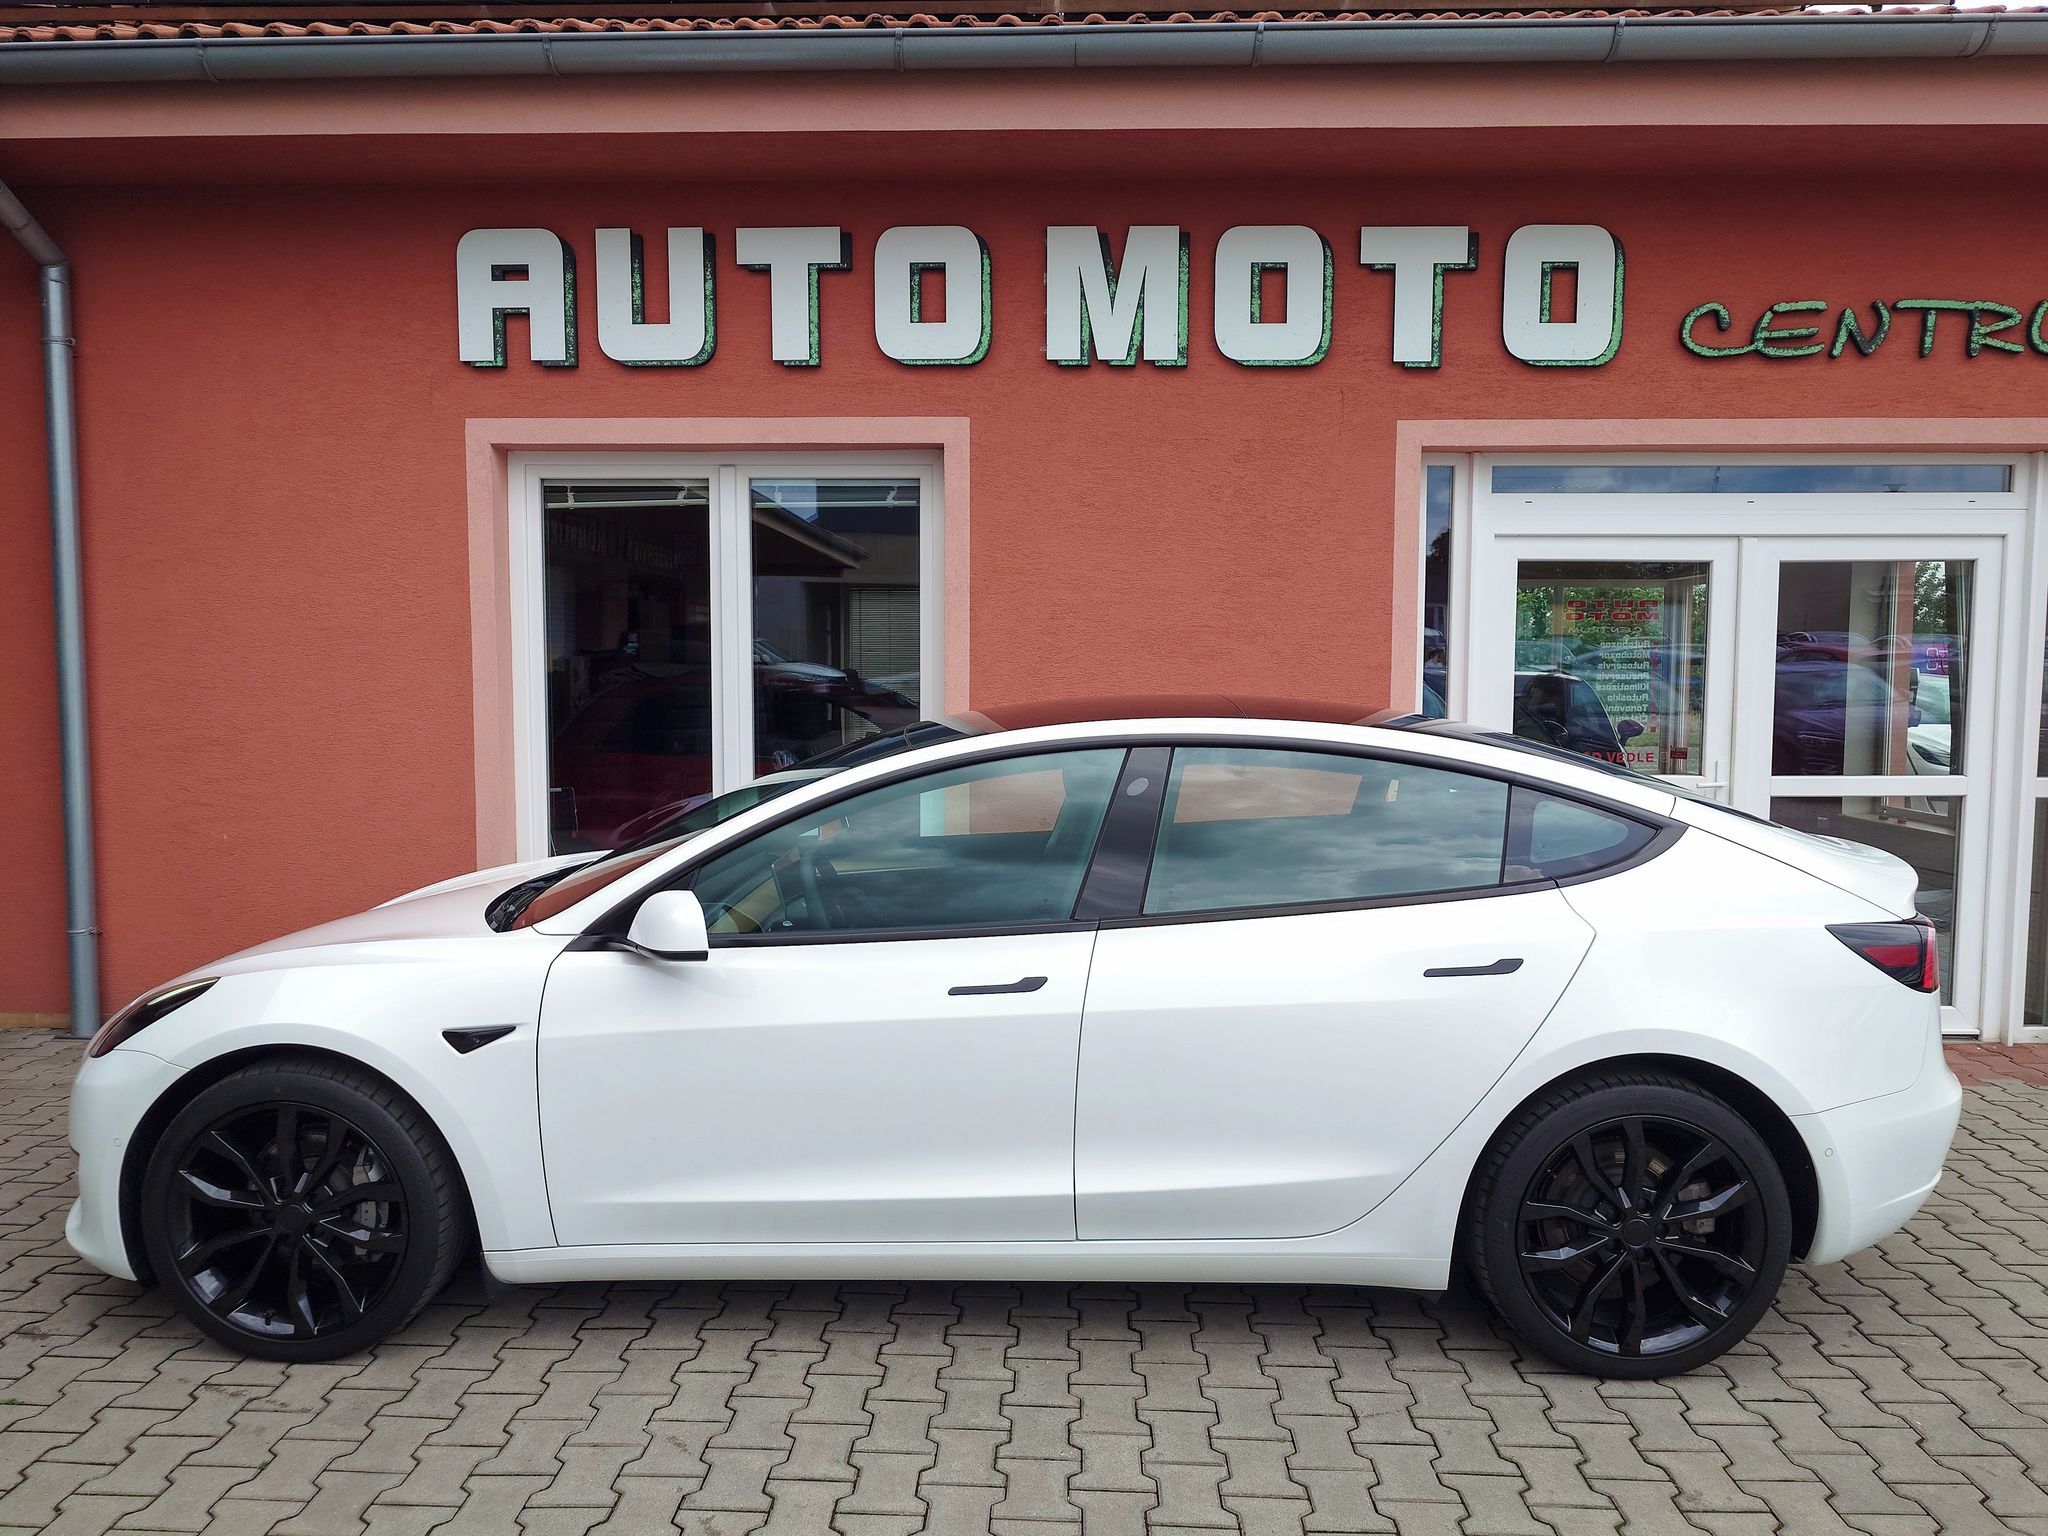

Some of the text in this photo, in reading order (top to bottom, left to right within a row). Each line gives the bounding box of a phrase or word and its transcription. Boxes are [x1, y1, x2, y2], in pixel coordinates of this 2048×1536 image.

[456, 225, 992, 368] AUTO
[1046, 224, 1625, 367] MOTO
[1606, 752, 1655, 763] VEDLE
